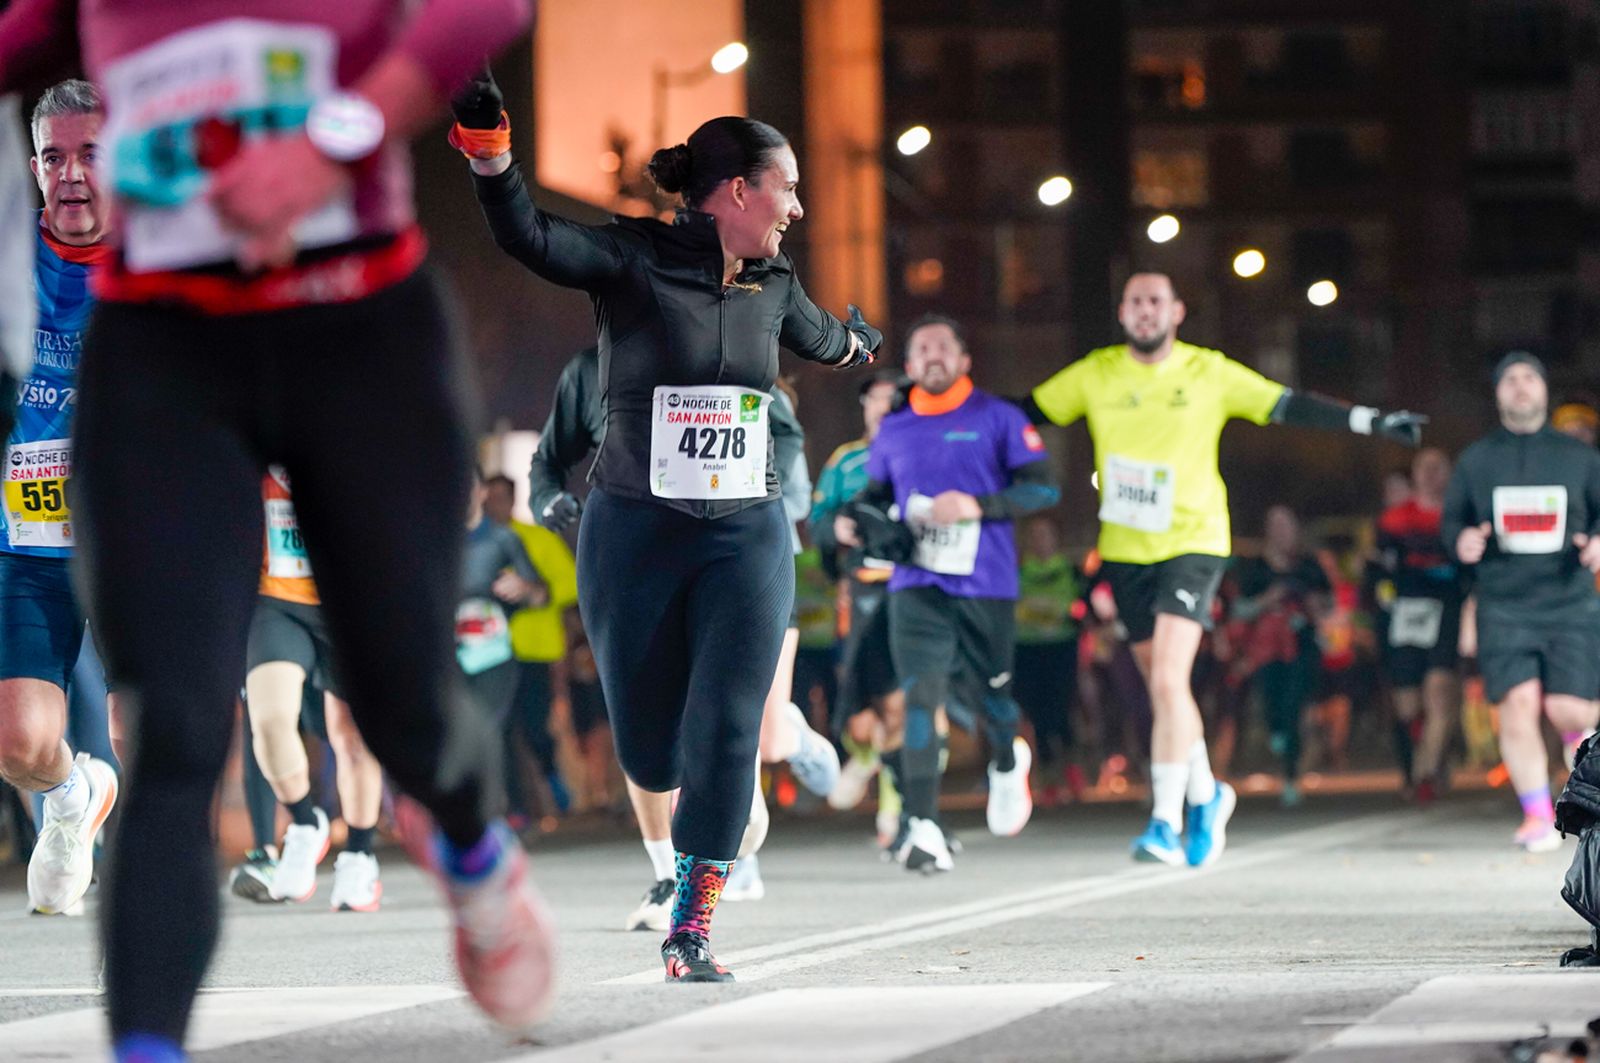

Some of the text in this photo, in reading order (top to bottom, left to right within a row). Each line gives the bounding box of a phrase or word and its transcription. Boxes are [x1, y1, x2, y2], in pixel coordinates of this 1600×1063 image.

[32, 350, 78, 370] AGRICOL
[682, 399, 718, 410] NOCHE
[720, 400, 732, 410] DE
[667, 412, 692, 423] SAN
[694, 411, 732, 424] ANTÓN
[678, 427, 746, 459] 4278
[25, 453, 58, 465] NOCHE
[11, 463, 73, 480] SAN ANTÓ
